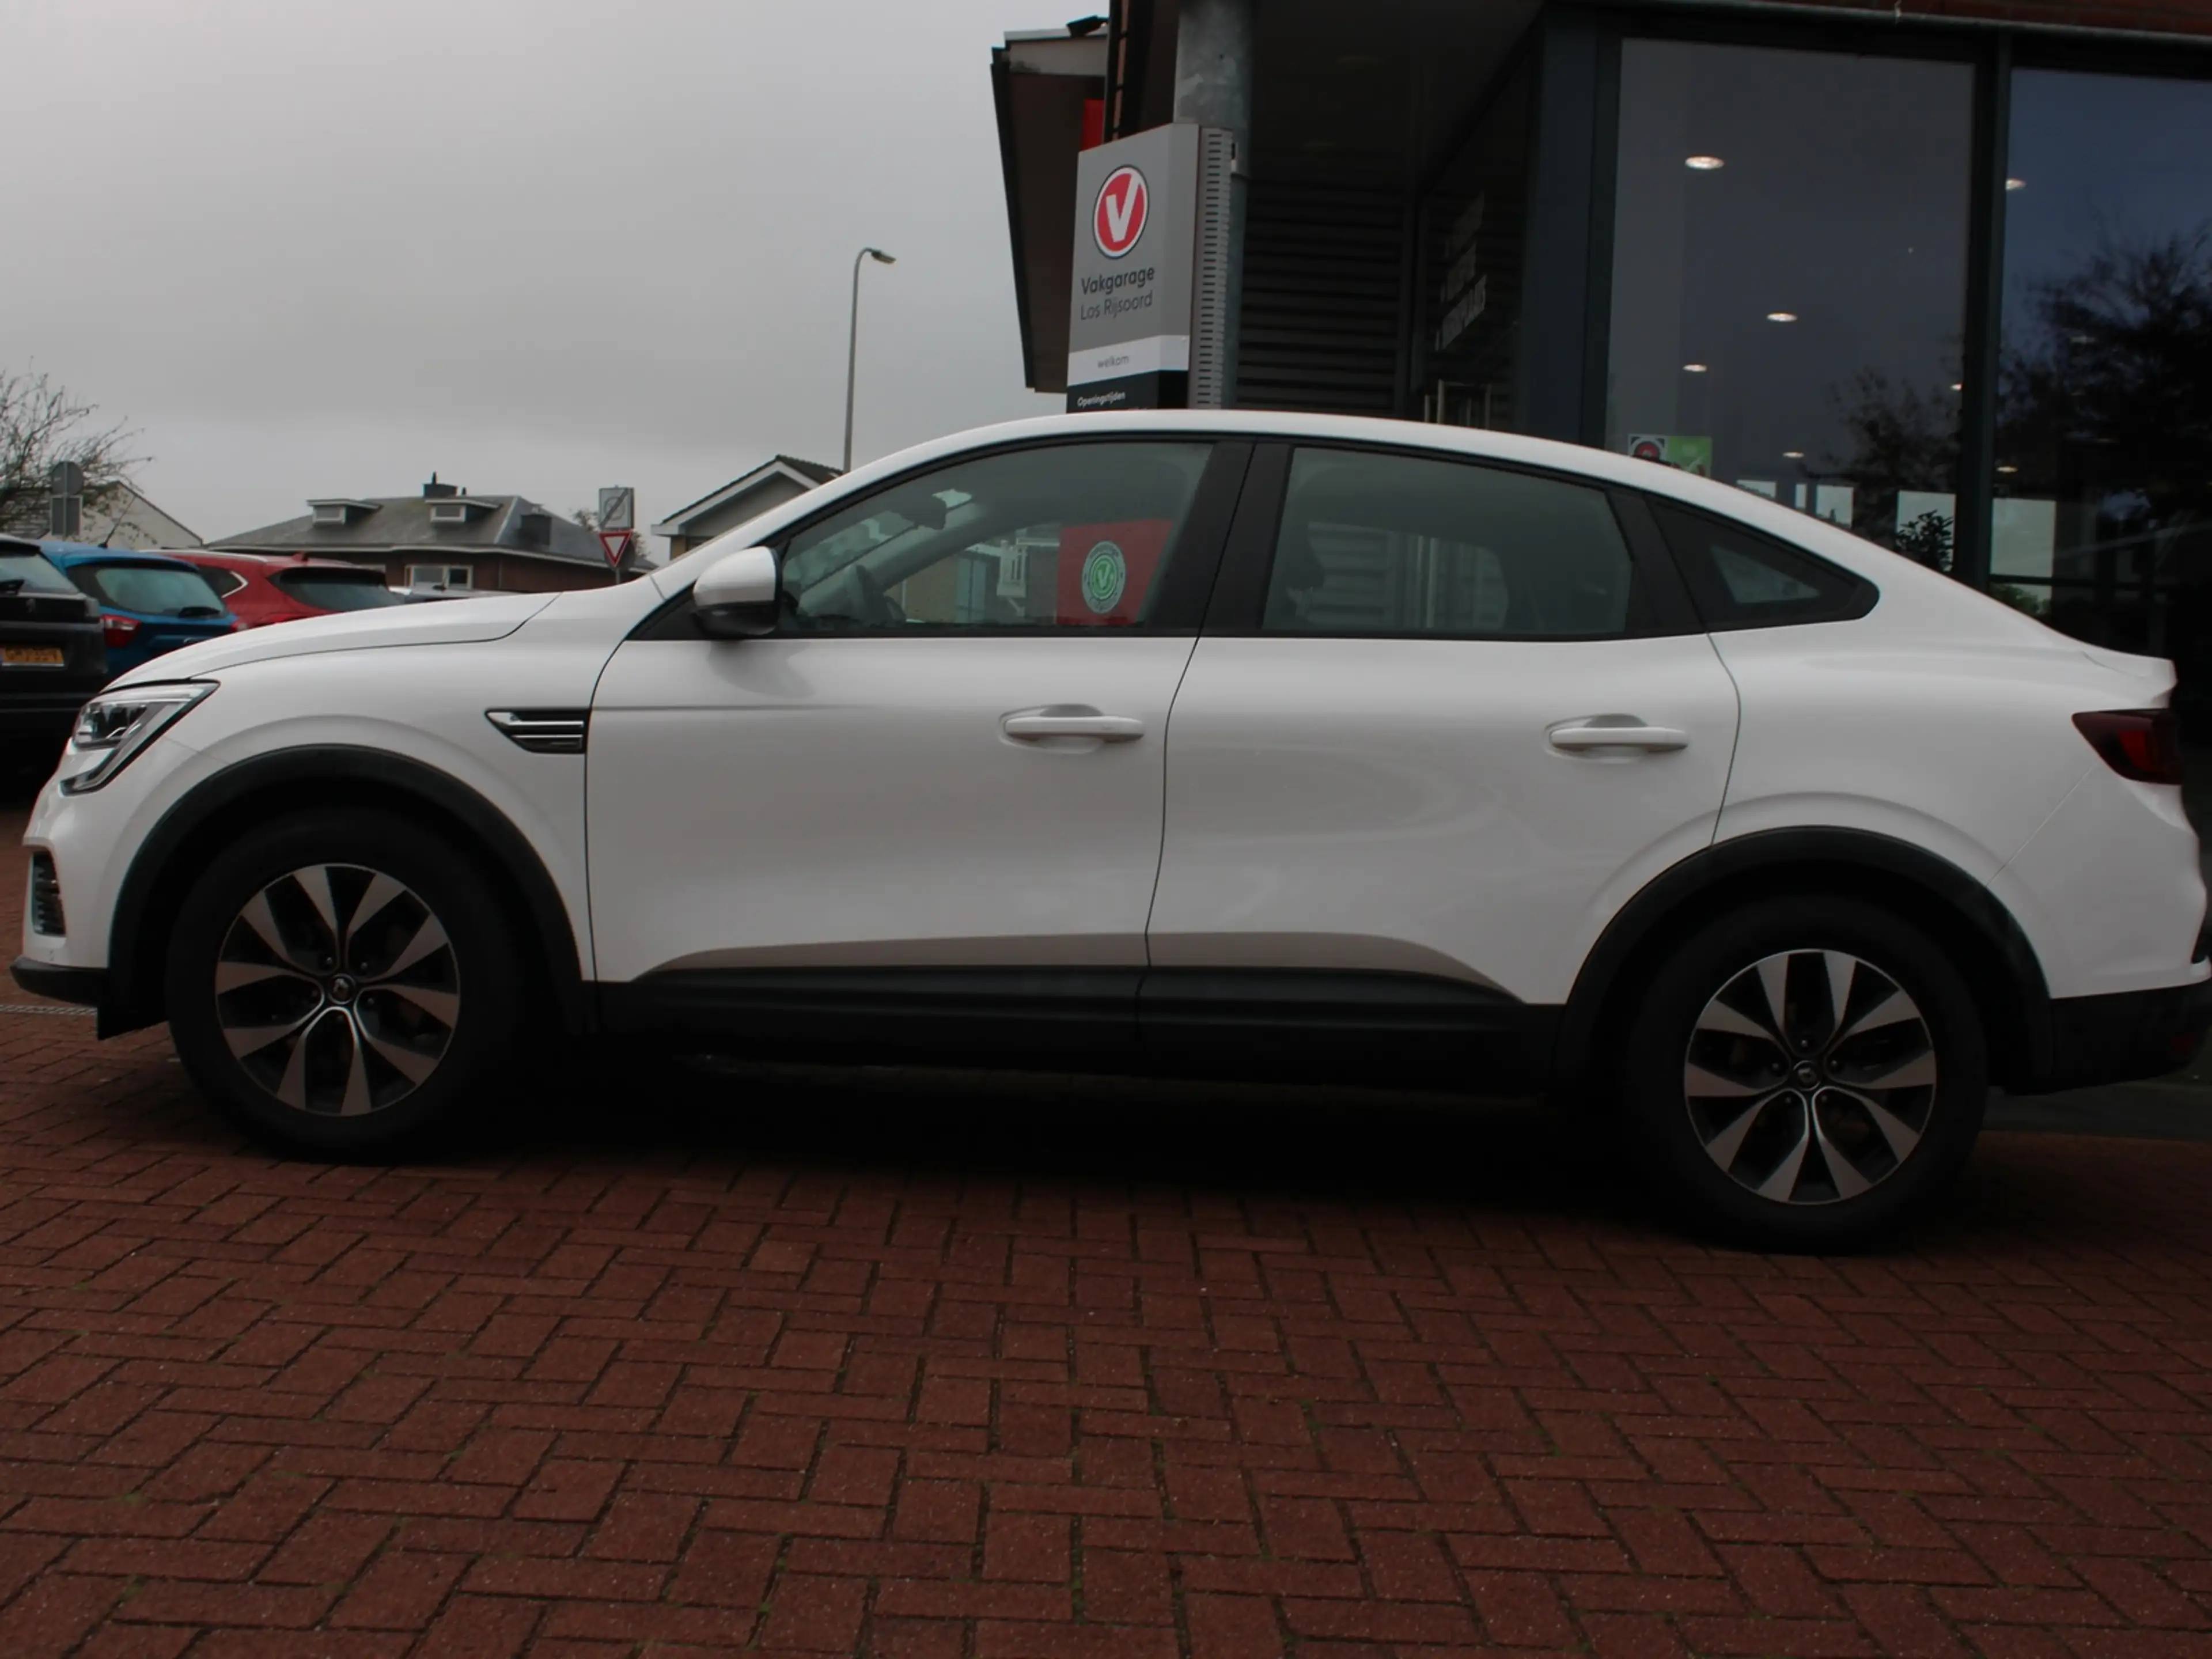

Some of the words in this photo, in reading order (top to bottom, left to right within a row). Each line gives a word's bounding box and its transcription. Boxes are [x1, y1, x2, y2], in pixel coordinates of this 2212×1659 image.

[1081, 267, 1155, 295] Vakgarage
[1081, 304, 1100, 320] Los
[1104, 290, 1153, 319] Rijsoord
[1097, 355, 1130, 368] welkom
[1077, 391, 1126, 408] Openingstijden
